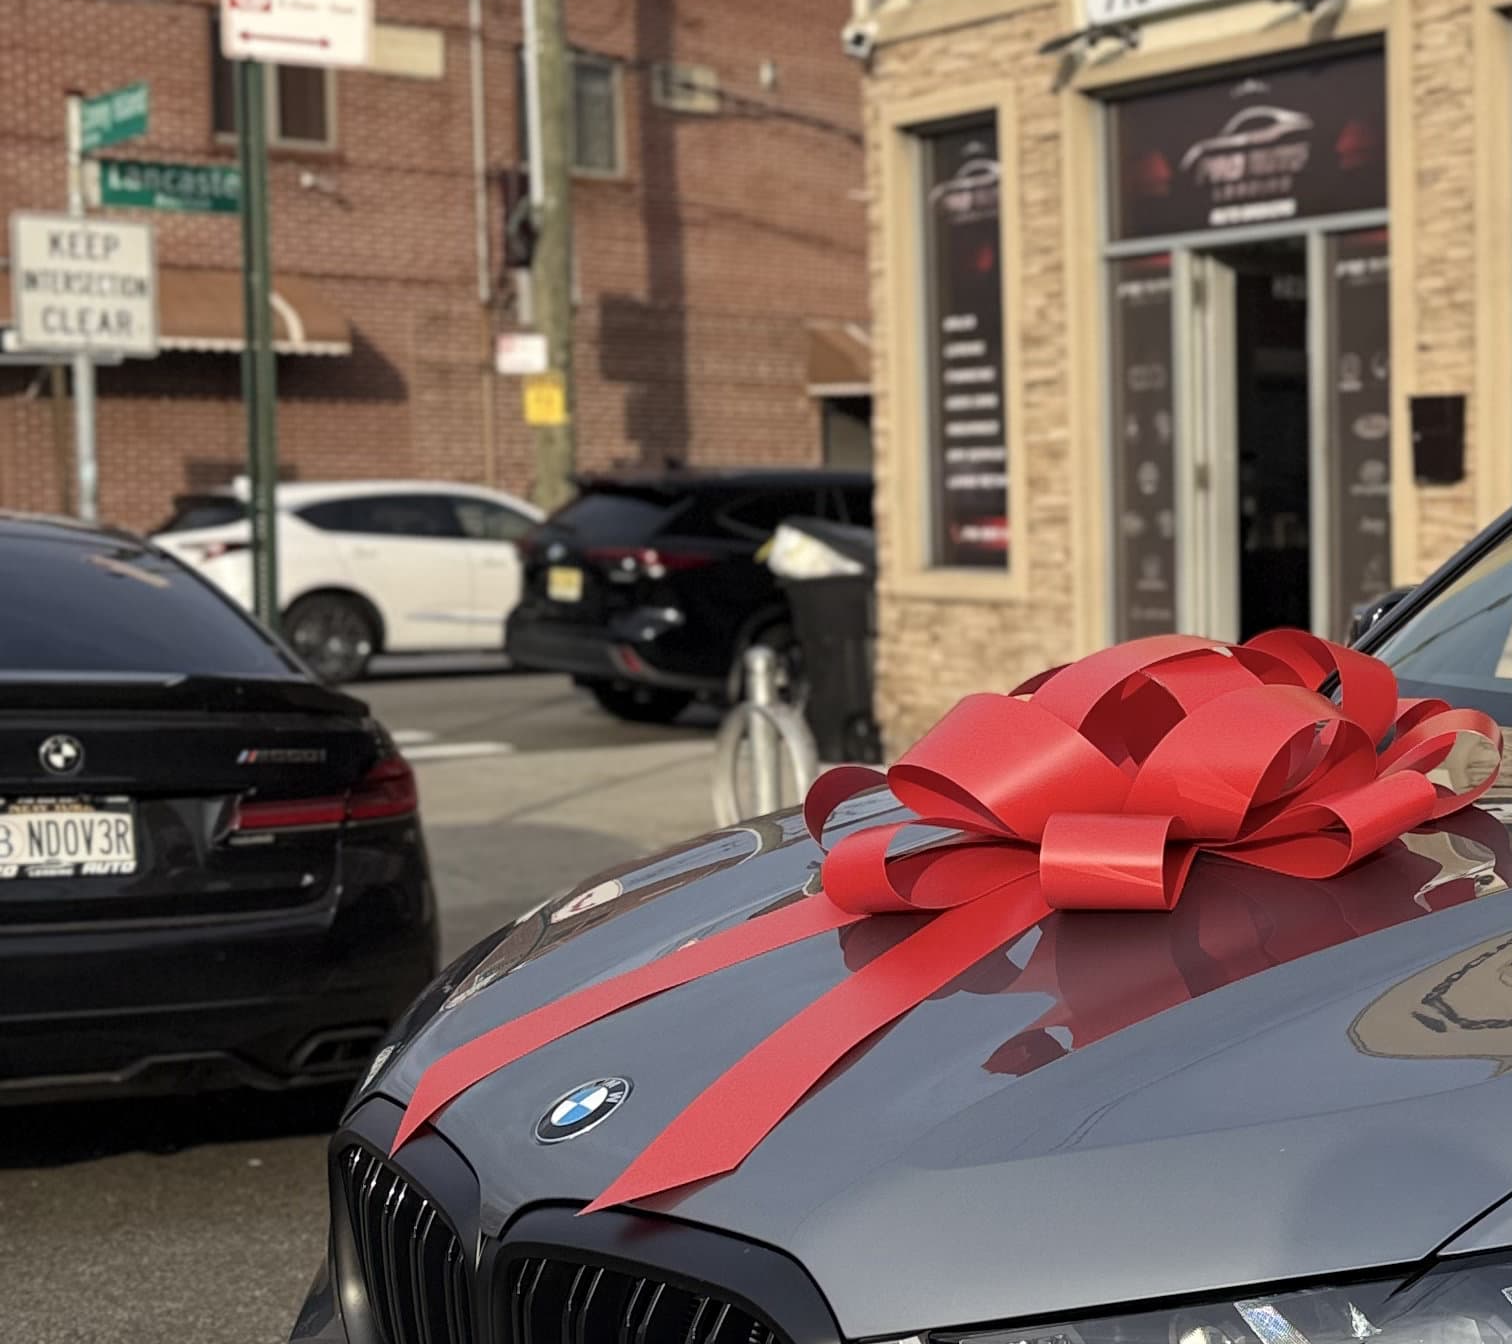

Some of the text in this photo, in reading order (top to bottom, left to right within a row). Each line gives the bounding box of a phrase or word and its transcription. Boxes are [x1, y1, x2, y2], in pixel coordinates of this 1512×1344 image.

[108, 160, 242, 193] Lancaste
[48, 232, 120, 262] KEEP
[24, 269, 147, 297] INTERSECTION
[41, 305, 133, 337] CLEAR
